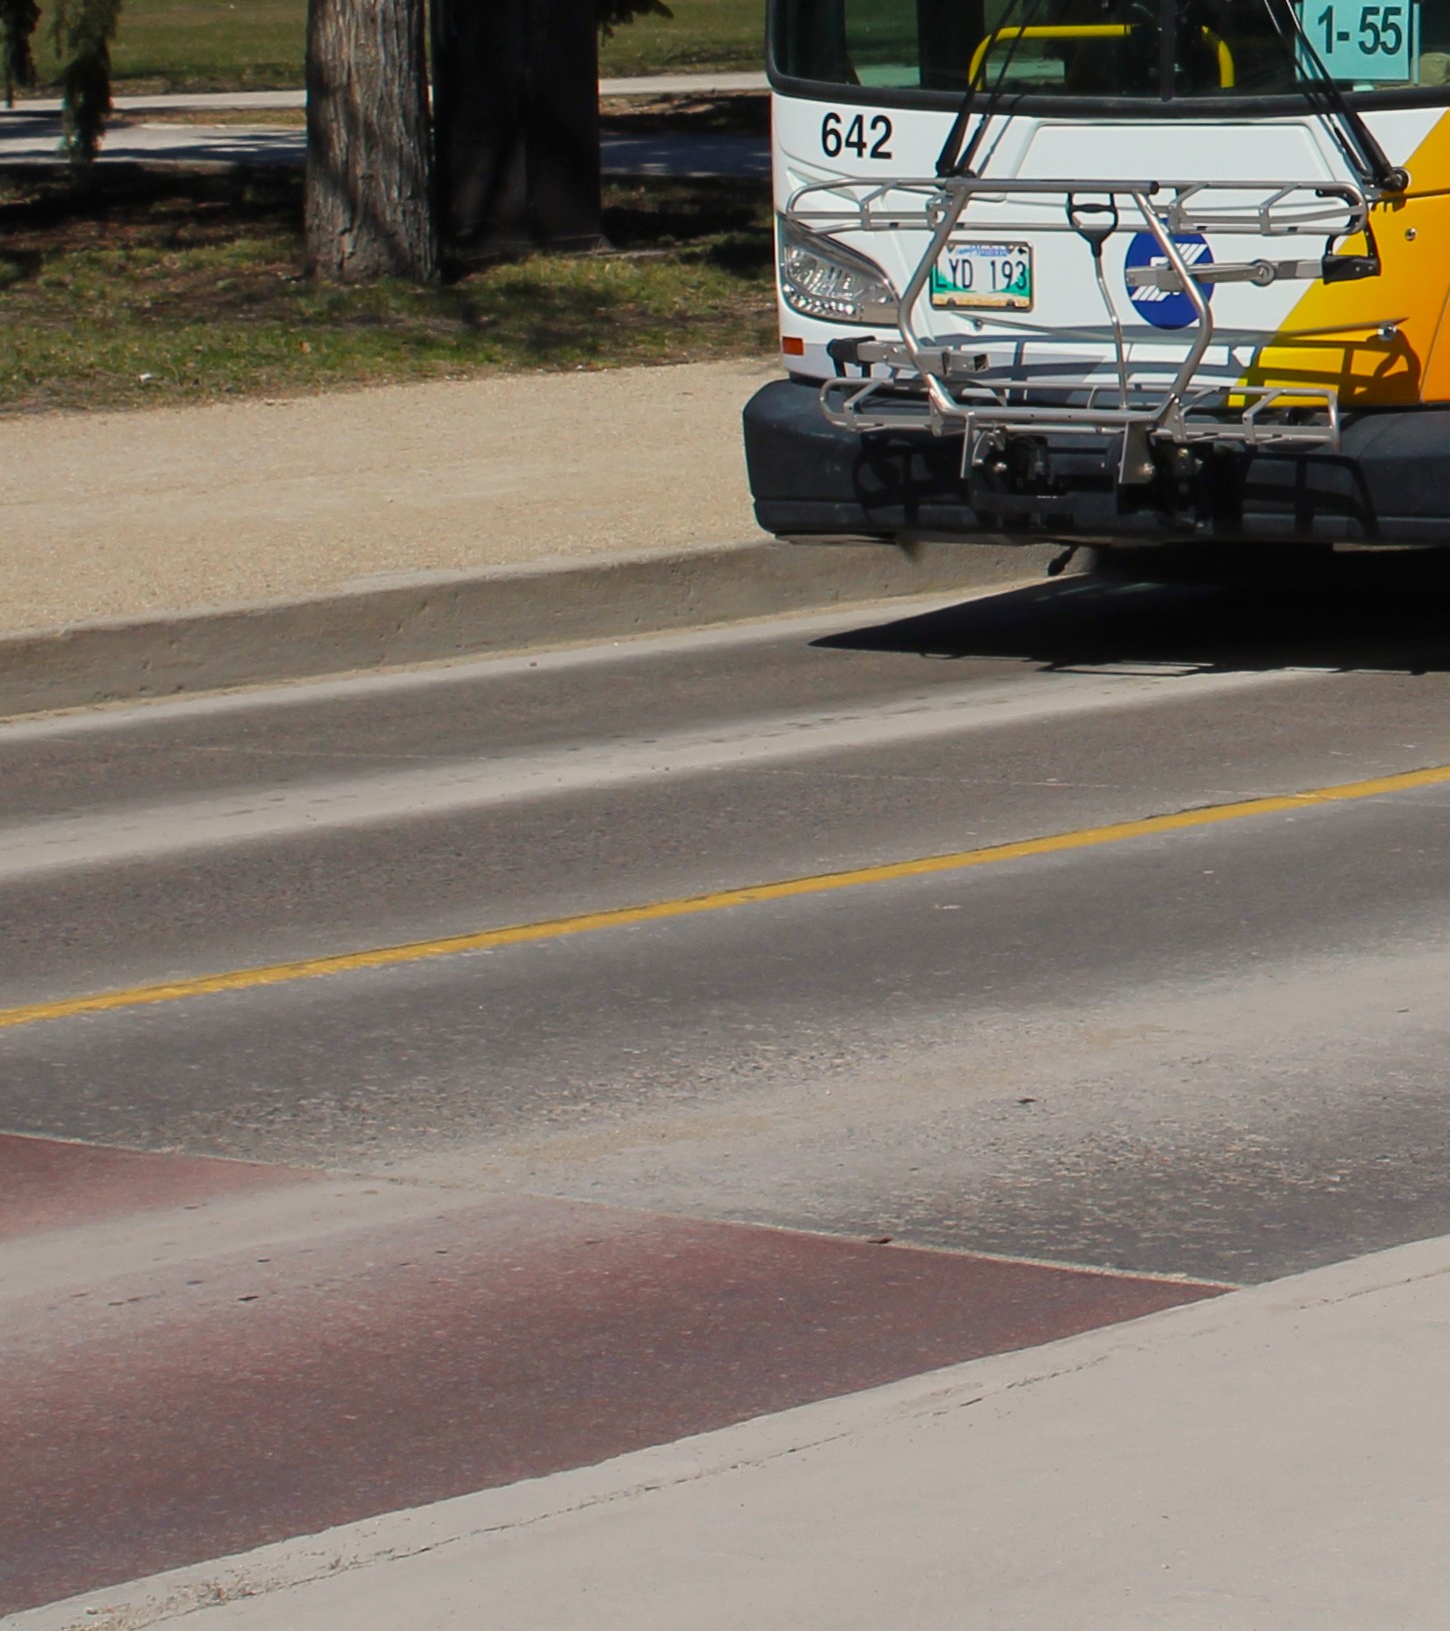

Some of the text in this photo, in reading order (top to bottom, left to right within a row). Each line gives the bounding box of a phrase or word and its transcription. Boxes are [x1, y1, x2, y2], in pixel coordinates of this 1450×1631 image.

[821, 112, 893, 160] 642
[935, 258, 1027, 291] LYD 193
